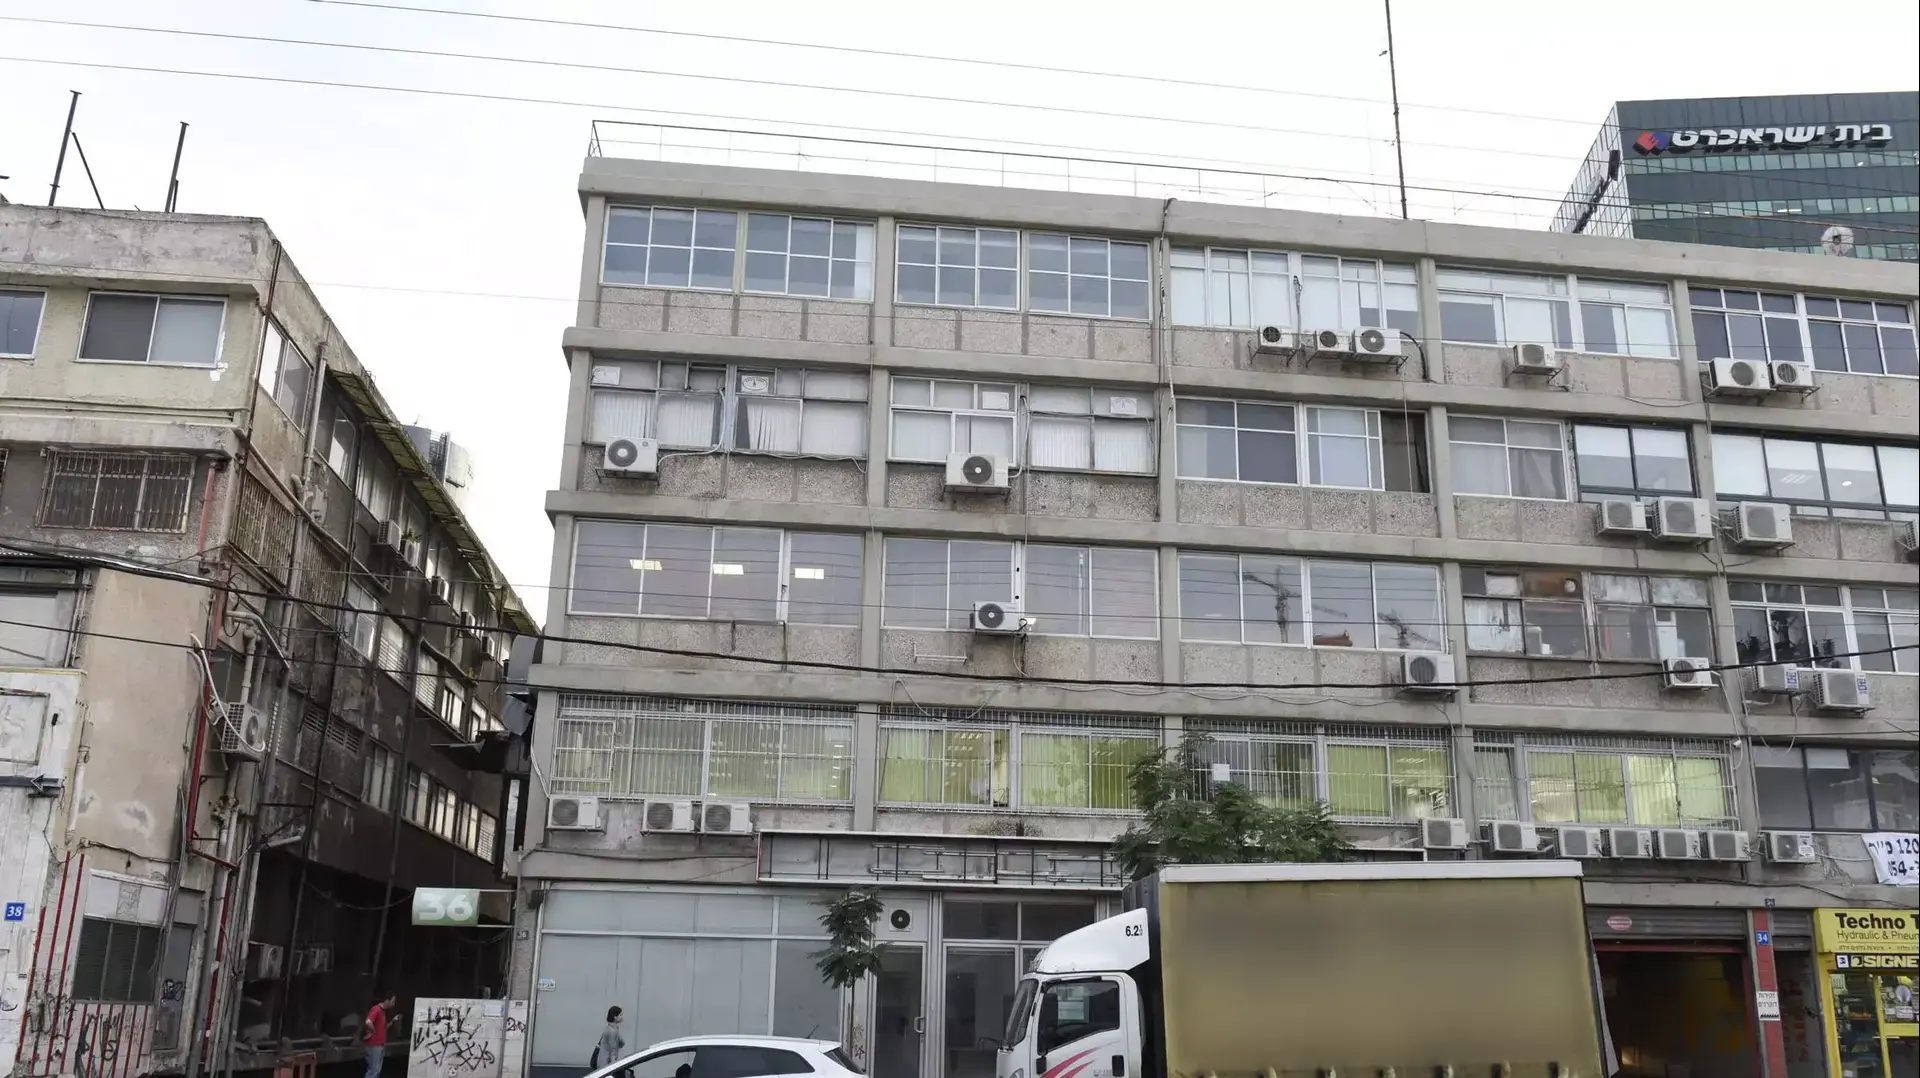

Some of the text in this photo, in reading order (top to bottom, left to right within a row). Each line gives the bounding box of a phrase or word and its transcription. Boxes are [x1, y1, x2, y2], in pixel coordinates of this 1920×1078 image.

[1671, 123, 1892, 147] בית ישראכרט
[7, 906, 22, 917] 38
[419, 894, 473, 921] 36
[1834, 912, 1906, 929] Techno
[1757, 932, 1768, 943] 34
[1837, 930, 1880, 941] Hydraulic
[1882, 931, 1889, 940] &
